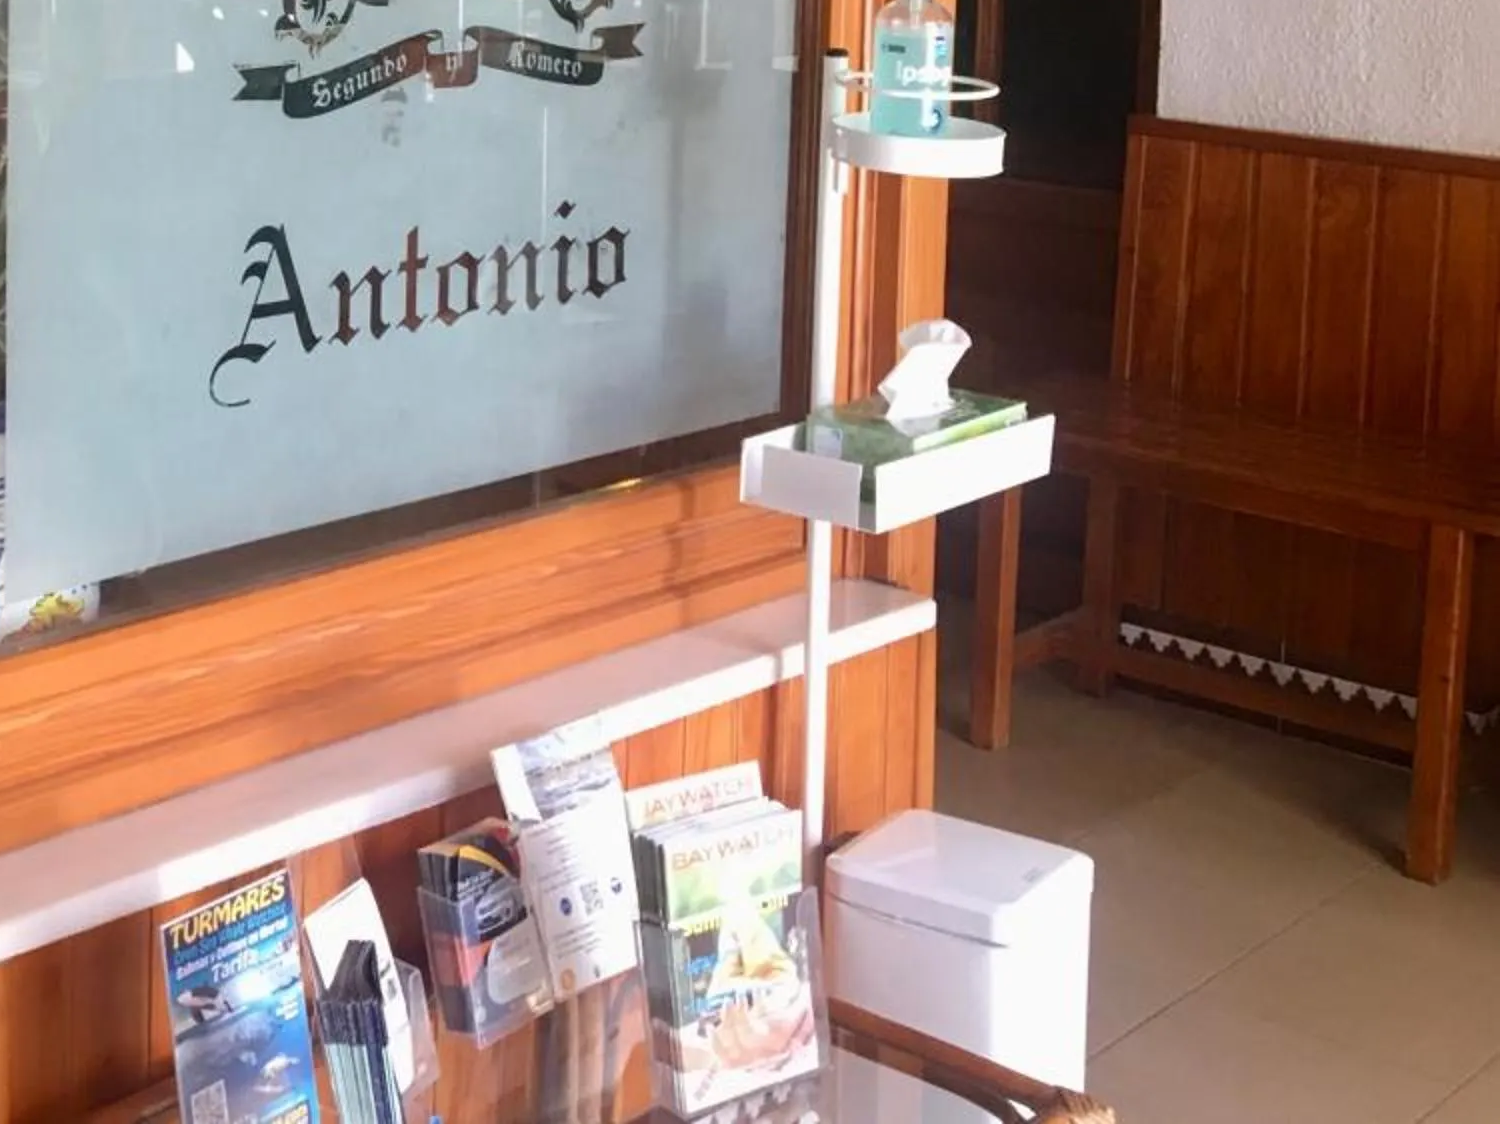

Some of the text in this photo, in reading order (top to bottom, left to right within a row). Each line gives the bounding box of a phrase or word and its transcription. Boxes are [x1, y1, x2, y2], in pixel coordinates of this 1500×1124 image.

[311, 52, 408, 109] Segundo
[508, 39, 583, 78] Romero
[209, 199, 630, 407] Antonio
[169, 874, 286, 950] TURMARES
